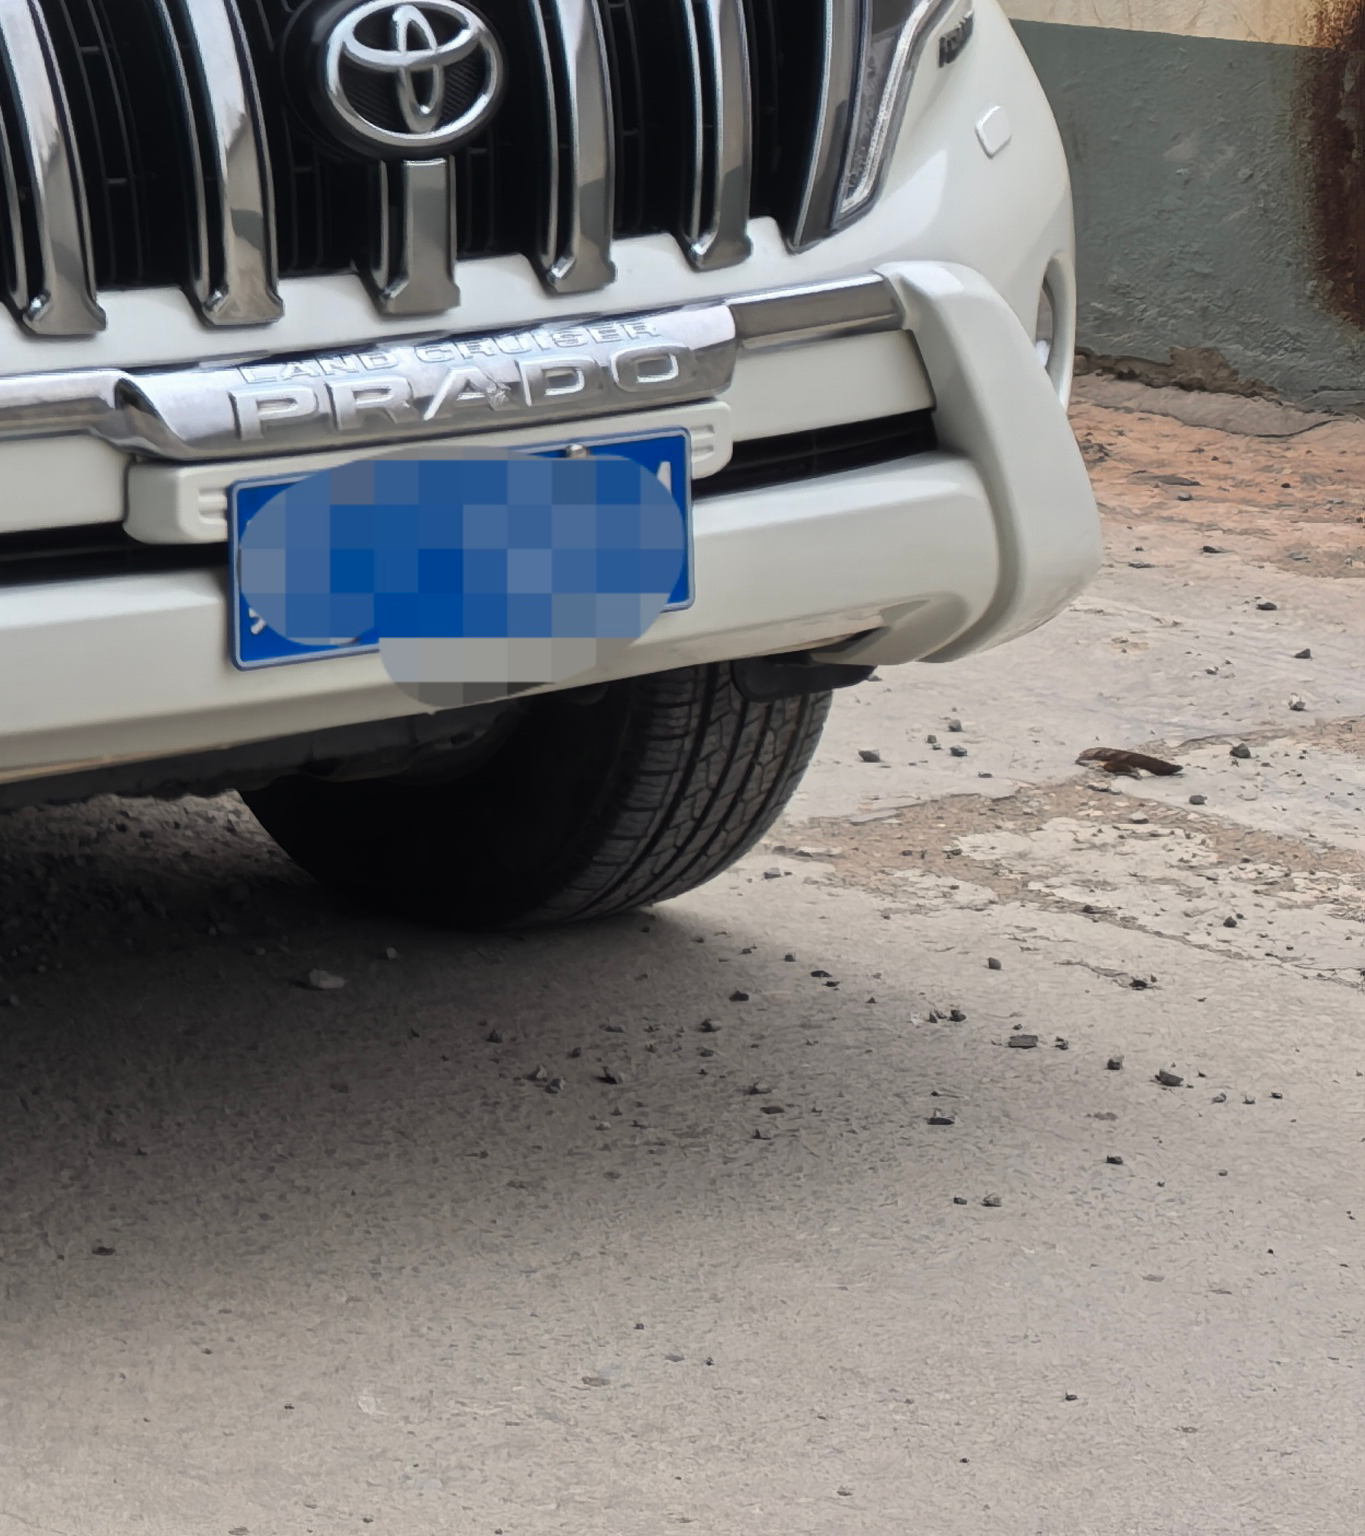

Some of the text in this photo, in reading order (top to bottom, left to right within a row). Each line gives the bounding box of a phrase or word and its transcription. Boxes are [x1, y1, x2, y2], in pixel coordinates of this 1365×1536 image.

[228, 343, 691, 441] PRADO
[237, 319, 662, 384] LAND CRUISER
